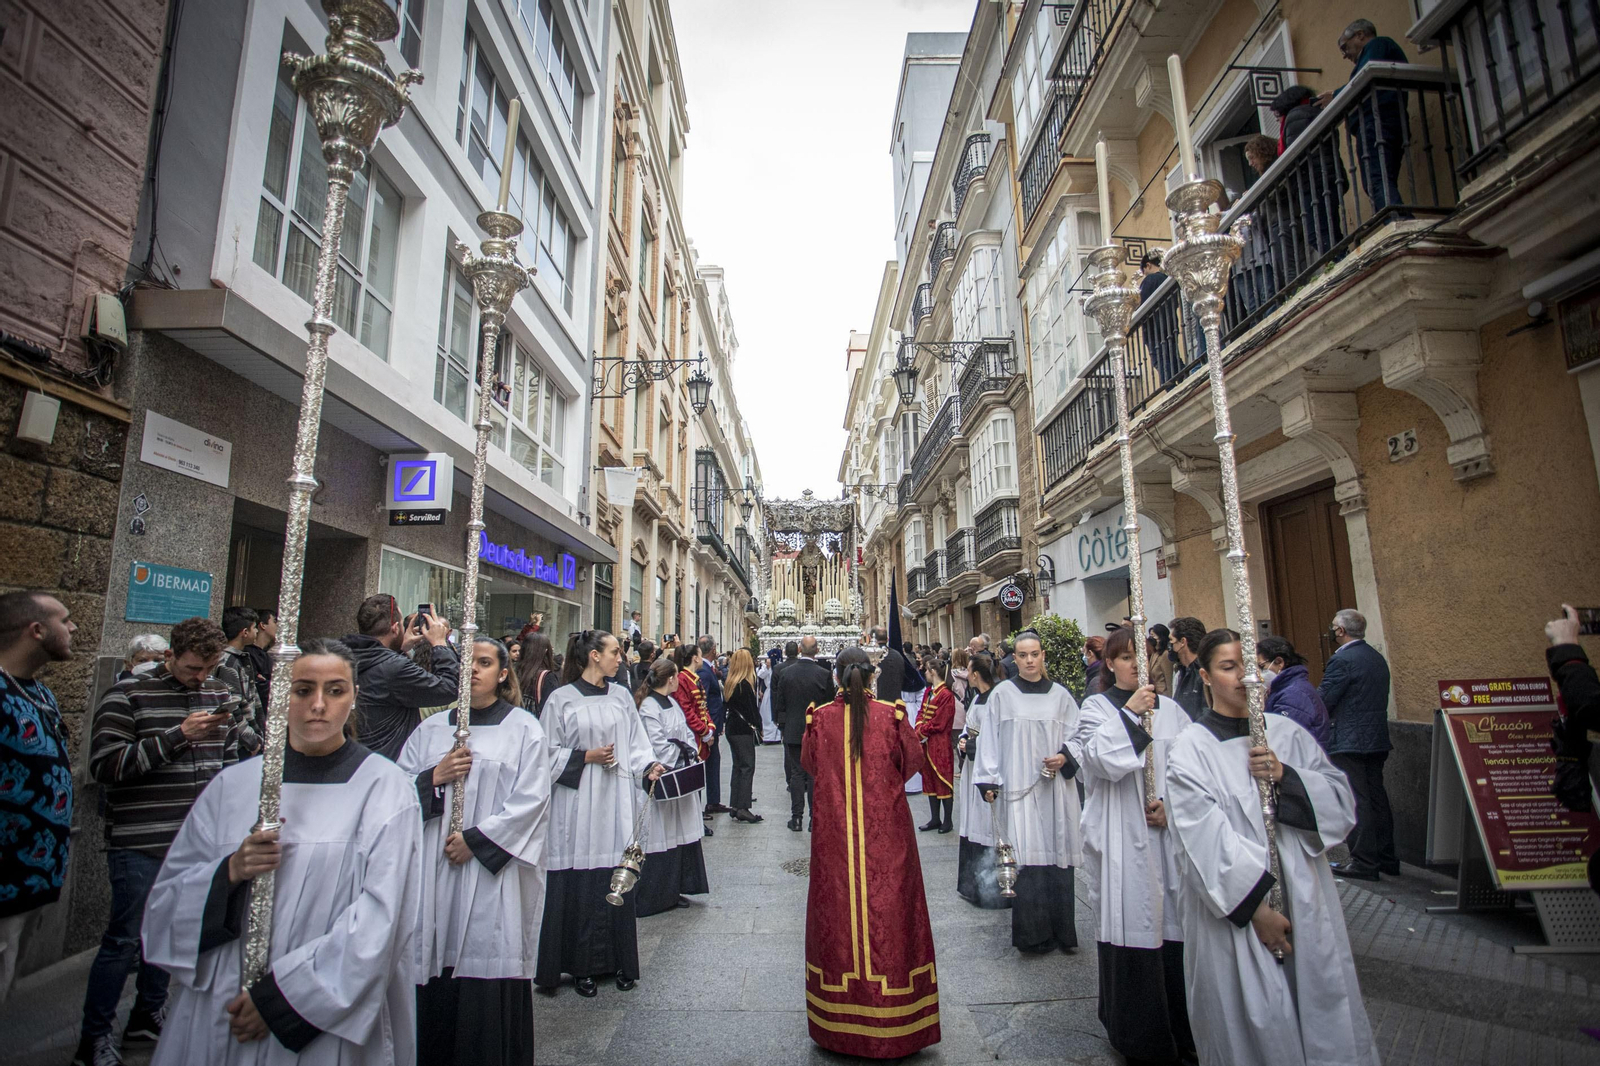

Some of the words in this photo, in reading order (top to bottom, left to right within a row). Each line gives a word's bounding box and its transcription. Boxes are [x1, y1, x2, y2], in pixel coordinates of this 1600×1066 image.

[1389, 430, 1417, 457] 25
[409, 513, 441, 522] ServiRed
[1078, 515, 1129, 571] Côté
[479, 529, 534, 576] Deutsche
[534, 555, 559, 585] Bank
[152, 573, 210, 593] IBERMAD
[1471, 683, 1489, 692] ENVÍOS
[1488, 681, 1512, 691] GRATIS
[1529, 682, 1548, 690] EUROPA
[1473, 694, 1491, 704] FREE
[1513, 695, 1531, 703] ACROSS
[1530, 694, 1550, 702] EUROPE
[1478, 715, 1533, 732] Chacón
[1483, 758, 1510, 766] Tienda
[1517, 756, 1557, 765] Exposición
